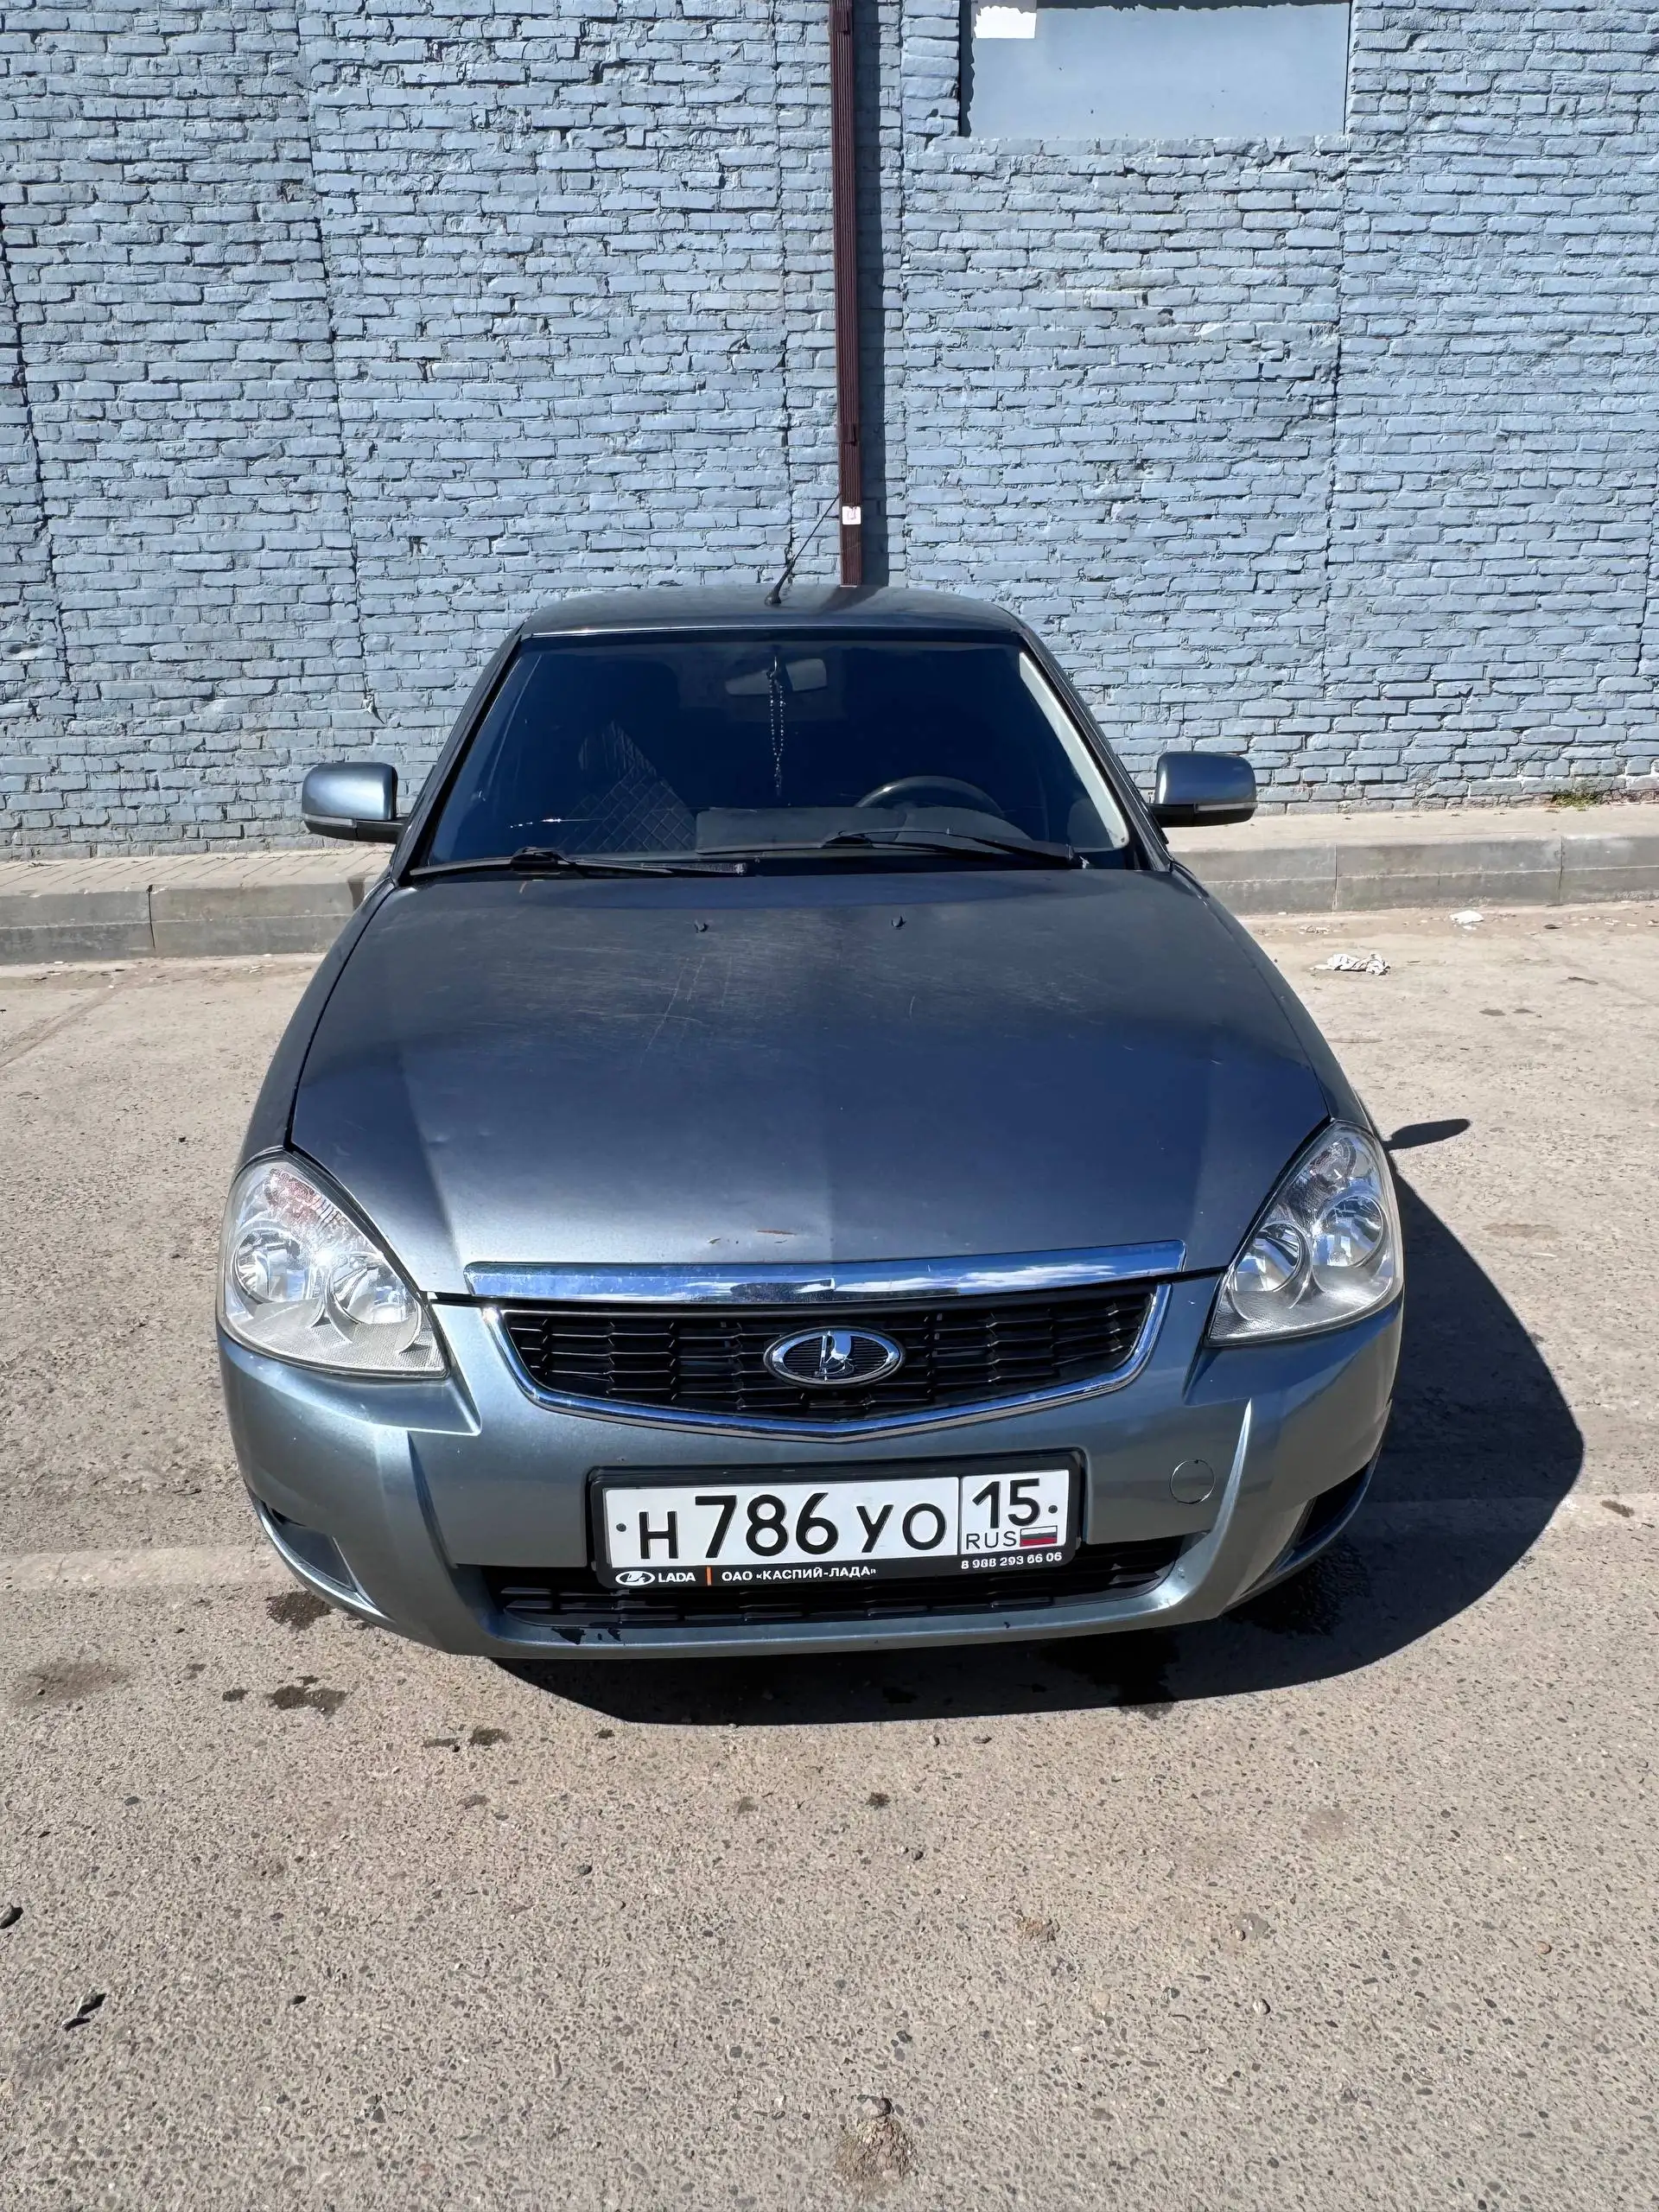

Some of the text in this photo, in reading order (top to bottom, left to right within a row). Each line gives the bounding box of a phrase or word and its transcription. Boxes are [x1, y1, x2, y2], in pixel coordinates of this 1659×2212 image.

[972, 1478, 1040, 1529] 15
[966, 1530, 1017, 1550] RUS
[961, 1560, 969, 1569] 8
[999, 1555, 1024, 1567] 293
[1046, 1551, 1063, 1562] 06
[658, 1572, 696, 1583] LADA
[721, 1571, 753, 1582] ОАО
